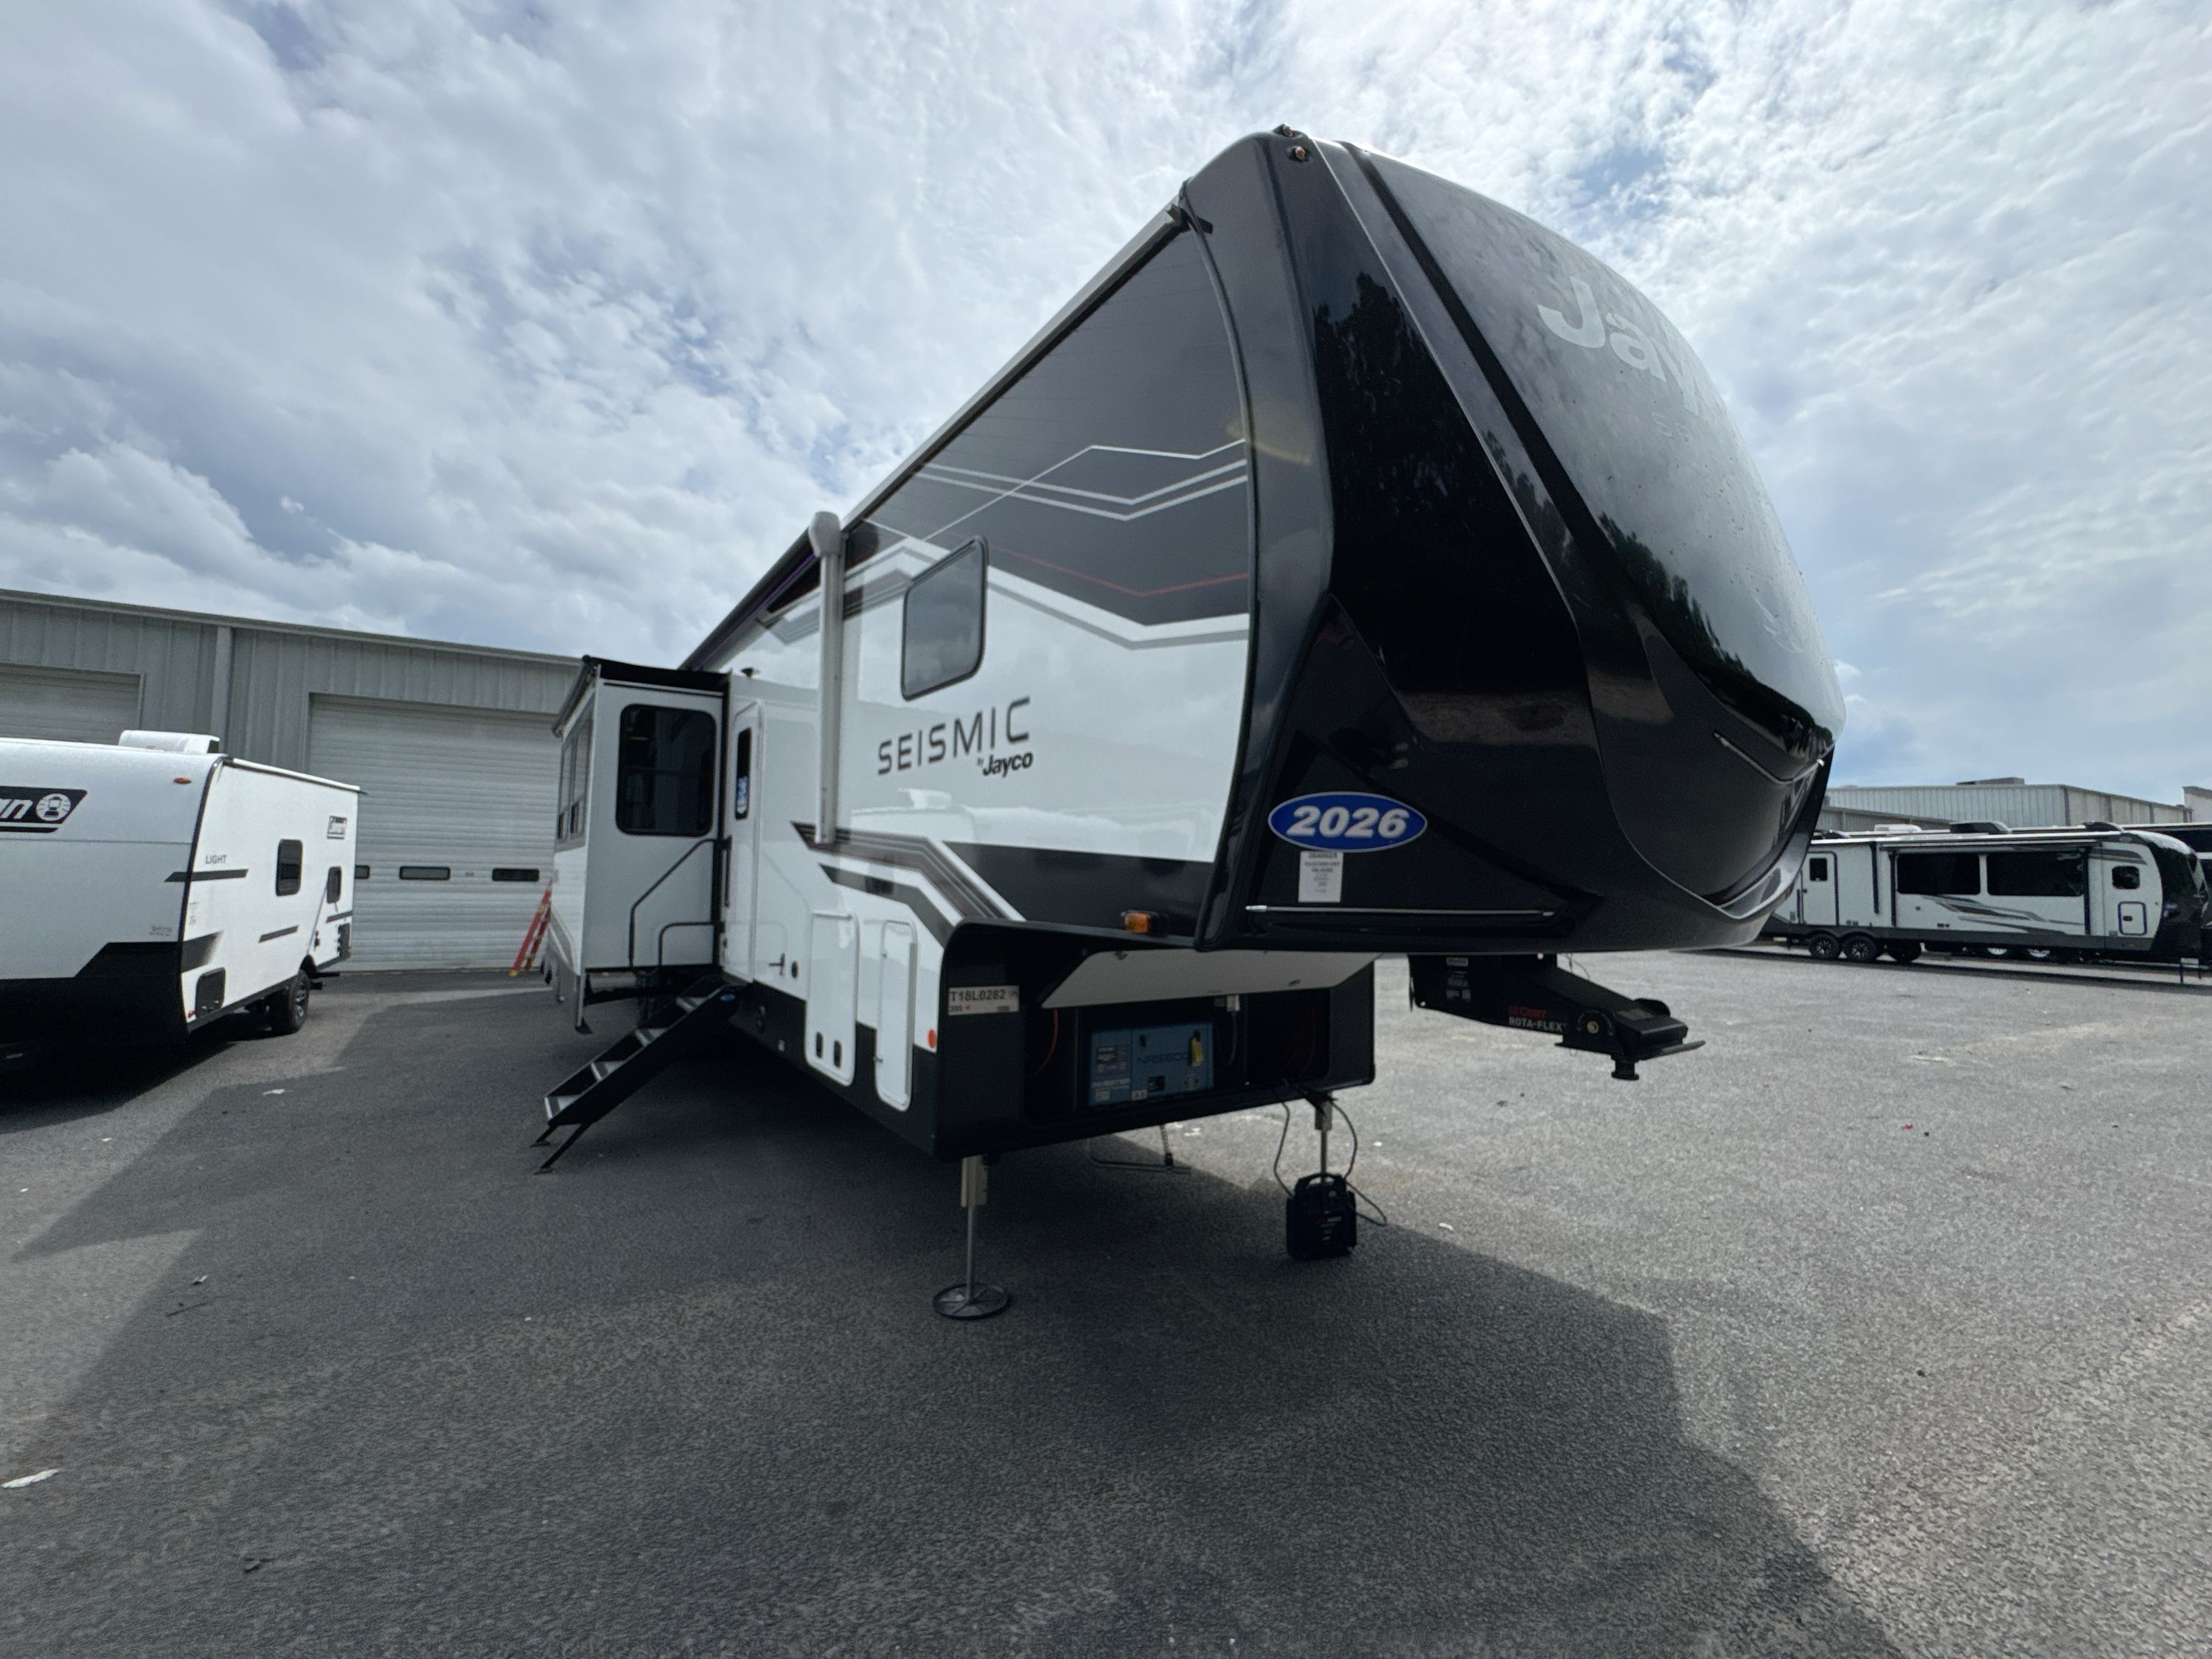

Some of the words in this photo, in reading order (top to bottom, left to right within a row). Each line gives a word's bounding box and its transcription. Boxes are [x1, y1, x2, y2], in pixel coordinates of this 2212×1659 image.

[877, 696, 1031, 776] SEISMIC
[983, 751, 1034, 779] Jayco
[1286, 805, 1411, 839] 2026
[205, 855, 227, 864] LIGHT
[950, 989, 1006, 1002] T18L0282
[1509, 1017, 1564, 1033] ROTA-FLEX
